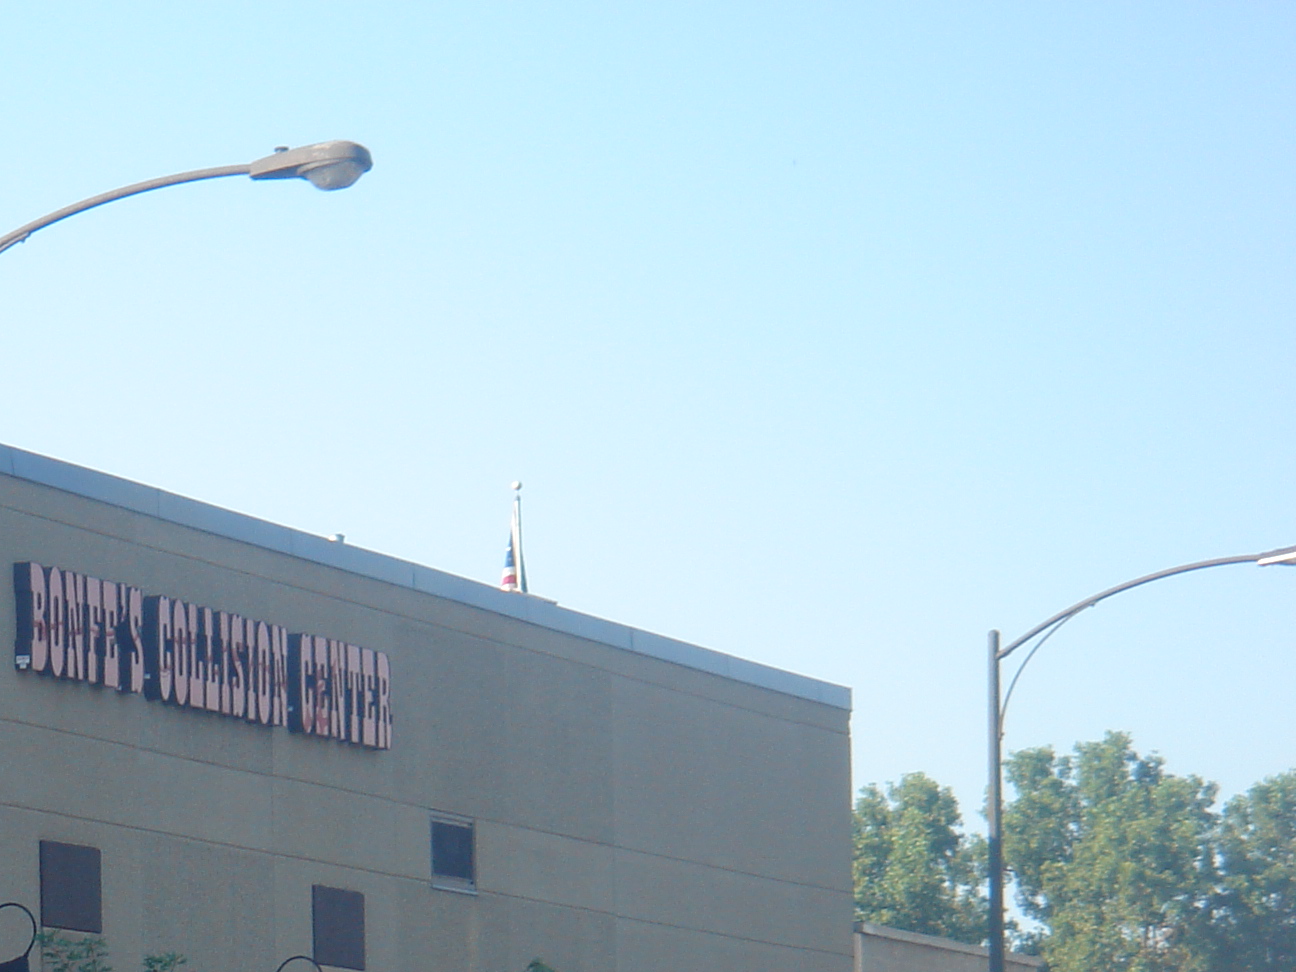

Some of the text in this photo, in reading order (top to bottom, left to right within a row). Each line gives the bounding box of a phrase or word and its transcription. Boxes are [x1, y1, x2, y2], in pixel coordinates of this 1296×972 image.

[26, 561, 393, 750] BONFE'S COLLISION CENTER
